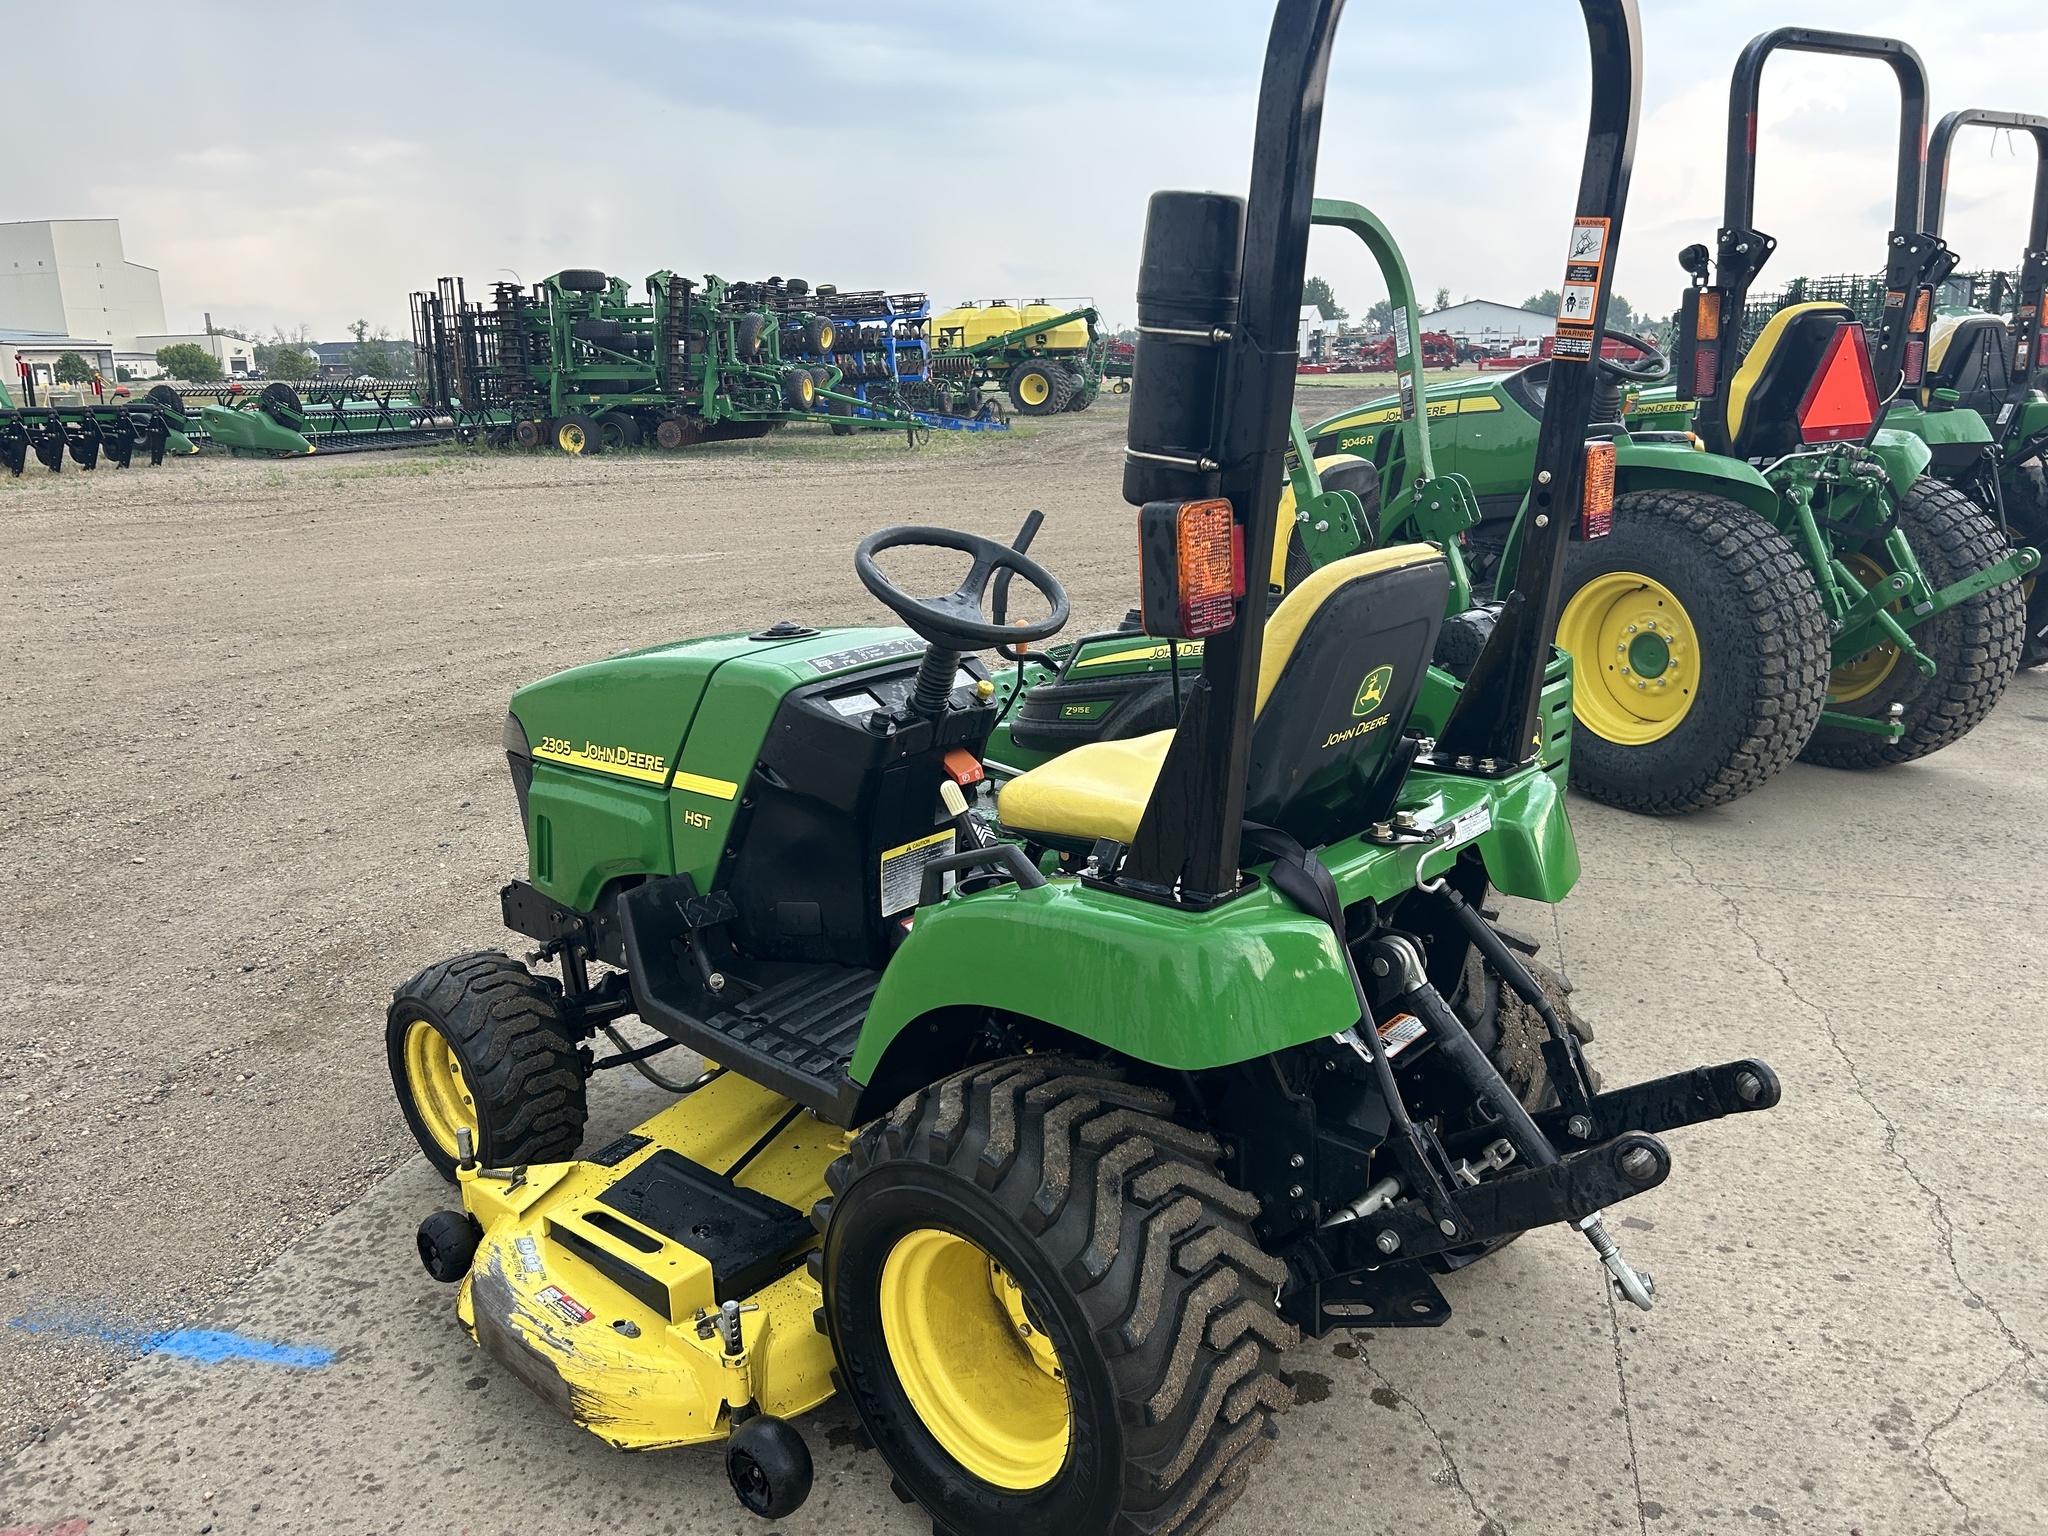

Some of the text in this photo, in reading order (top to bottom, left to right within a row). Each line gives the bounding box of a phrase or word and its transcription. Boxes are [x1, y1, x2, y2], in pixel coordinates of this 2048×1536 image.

[1382, 405, 1448, 422] JOH ERE
[1655, 403, 1688, 412] DEERE
[1341, 435, 1375, 450] 3046R
[1182, 643, 1205, 655] DEE
[1065, 706, 1091, 716] Z915E
[1321, 713, 1391, 748] JOHN DEERE
[541, 736, 666, 772] 2305 JOHN DEERE
[684, 809, 712, 830] HST
[912, 838, 931, 849] CAUTION
[515, 1236, 545, 1274] EDGE
